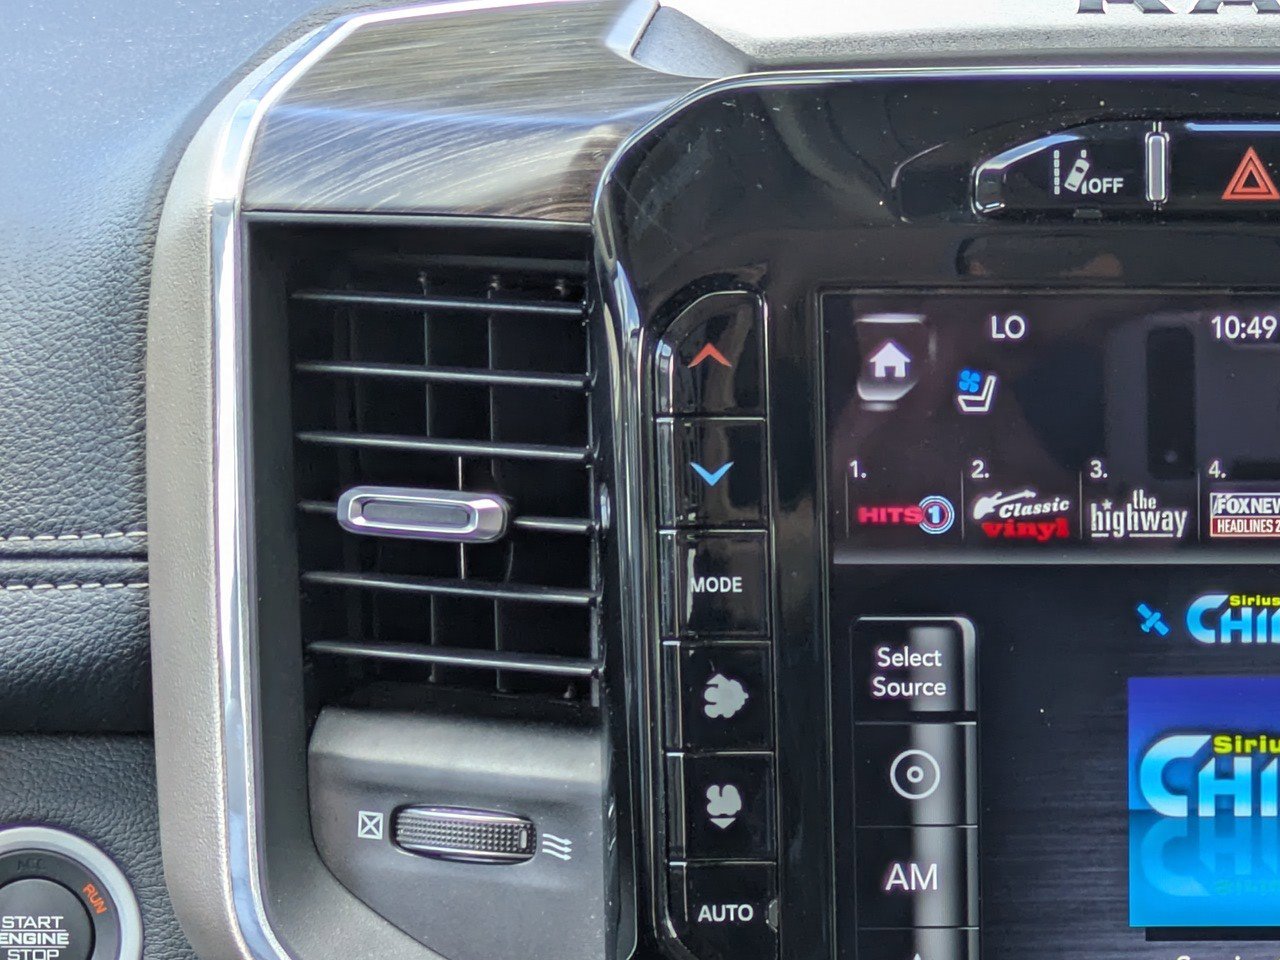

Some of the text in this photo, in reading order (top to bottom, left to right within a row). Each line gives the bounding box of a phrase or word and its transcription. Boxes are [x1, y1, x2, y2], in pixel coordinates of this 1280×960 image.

[1088, 177, 1124, 194] OFF
[990, 315, 1026, 340] LO
[1211, 315, 1278, 340] 10:49
[850, 460, 867, 479] 1.
[972, 460, 990, 479] 2.
[1090, 460, 1108, 479] 3.
[1208, 460, 1227, 479] 4.
[1132, 489, 1157, 510] the
[857, 506, 923, 525] HITS
[999, 499, 1070, 520] Classic
[1091, 503, 1187, 537] highway
[1217, 518, 1273, 533] HEADLINES
[982, 519, 1070, 542] vinyl
[690, 577, 743, 593] MODE
[876, 646, 943, 667] Select
[872, 676, 947, 697] Source
[885, 863, 938, 891] AM
[82, 882, 107, 914] RUN
[1, 915, 64, 928] START
[697, 905, 754, 923] AUTO
[0, 932, 69, 945] ENGINE
